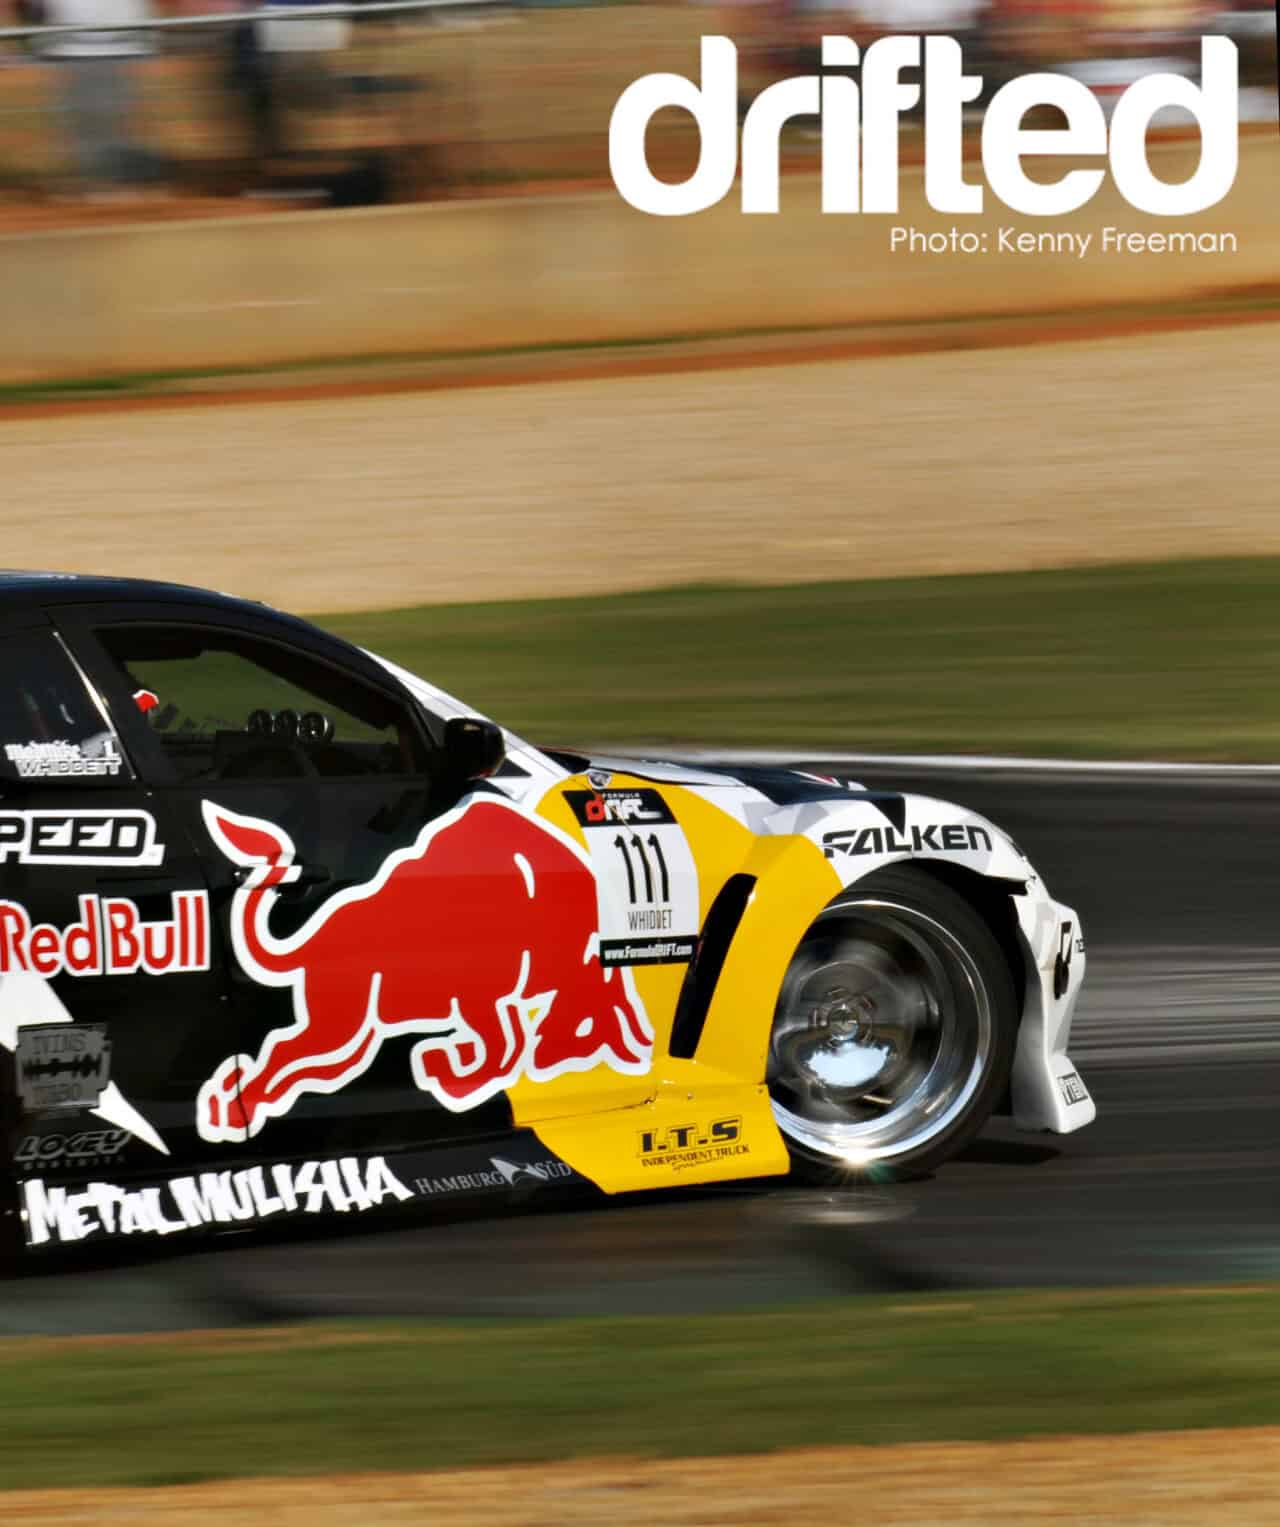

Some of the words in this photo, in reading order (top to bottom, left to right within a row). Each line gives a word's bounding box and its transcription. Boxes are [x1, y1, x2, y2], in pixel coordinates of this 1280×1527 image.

[613, 832, 670, 905] 111
[821, 823, 993, 859] FALKEN
[105, 892, 208, 974] Bull
[167, 1155, 414, 1224] MULISHA
[415, 1171, 506, 1195] HAMBURG
[535, 1160, 573, 1179] SÜD
